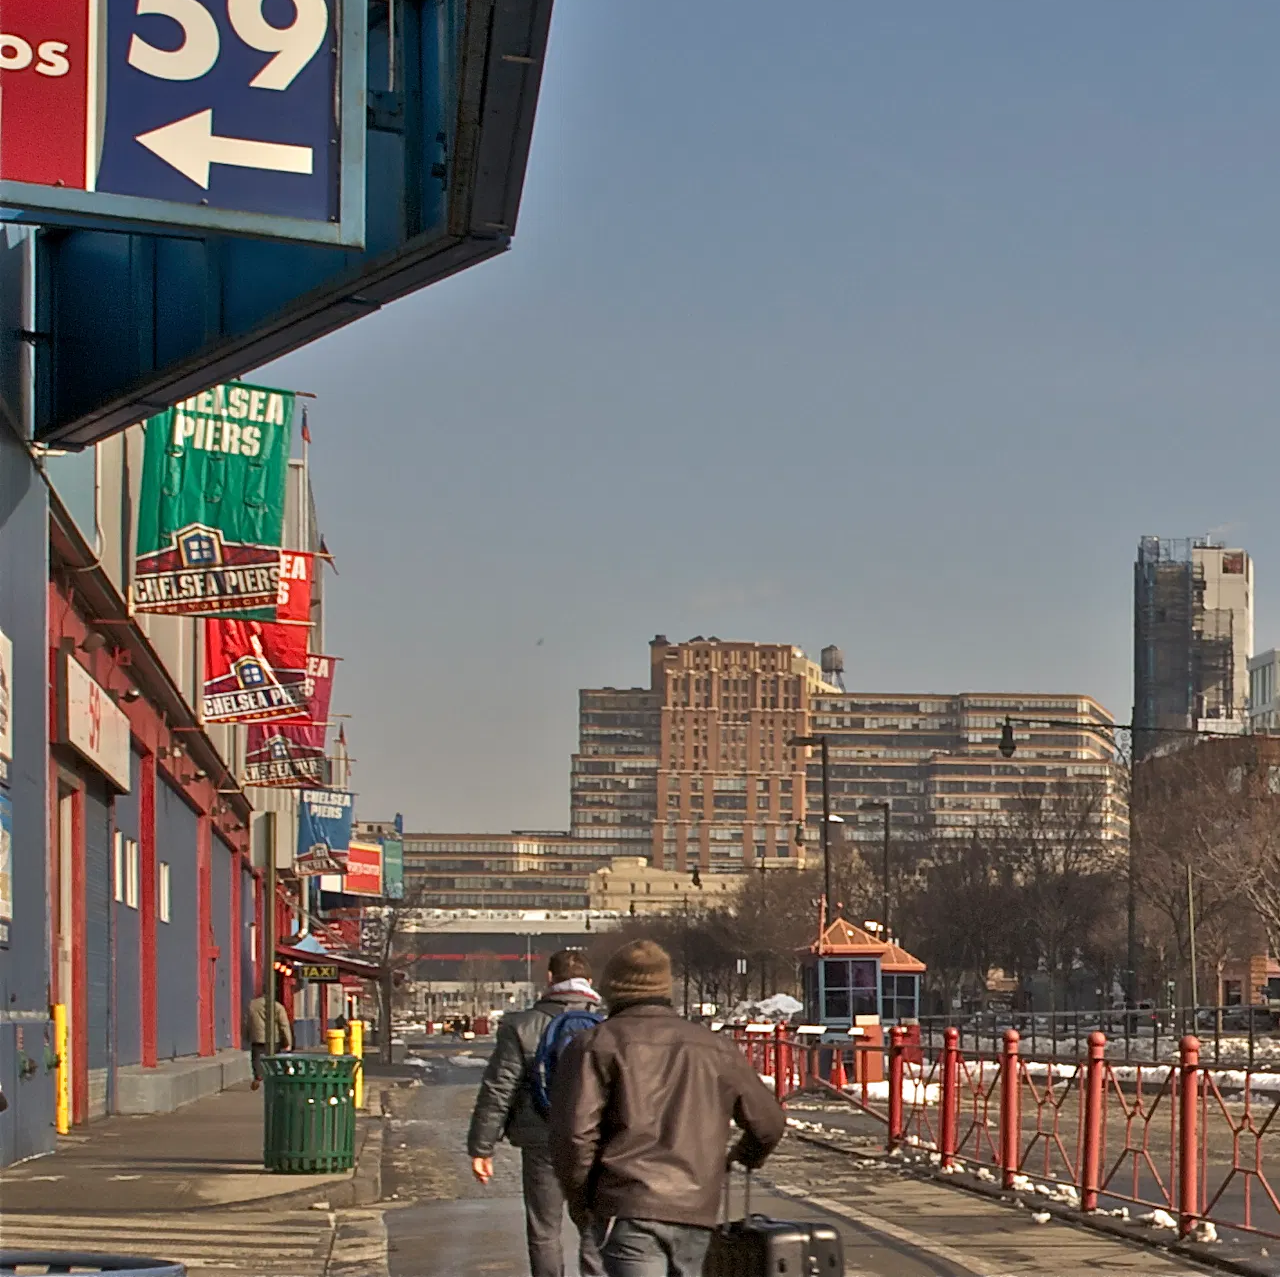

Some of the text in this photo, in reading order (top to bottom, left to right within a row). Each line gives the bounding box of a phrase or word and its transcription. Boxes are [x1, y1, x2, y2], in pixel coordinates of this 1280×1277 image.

[173, 413, 262, 457] PIERS
[134, 572, 220, 603] CHELSEA
[224, 567, 280, 595] PIERS
[203, 690, 269, 716] CHELSEA
[303, 790, 351, 807] CHELSEA
[311, 804, 343, 819] PIERS
[303, 966, 335, 978] TAXI
